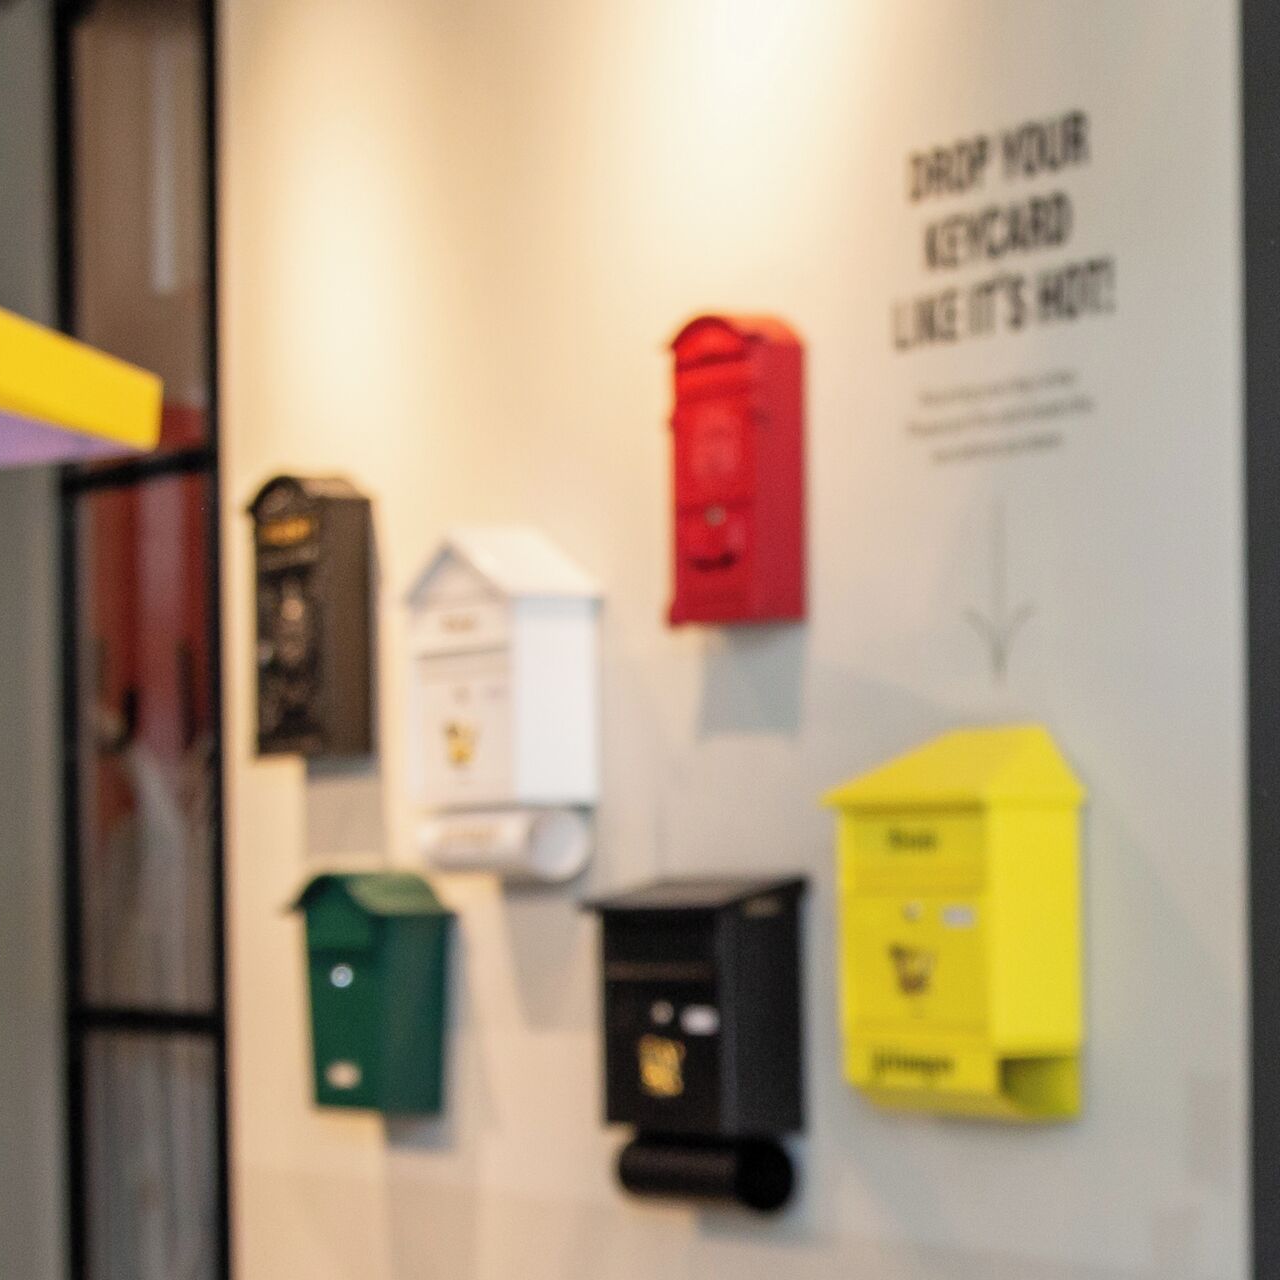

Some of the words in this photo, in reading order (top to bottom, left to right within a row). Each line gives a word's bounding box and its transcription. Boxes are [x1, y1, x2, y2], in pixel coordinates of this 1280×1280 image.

[910, 133, 989, 203] DROP
[1002, 110, 1090, 180] YOUR
[925, 190, 1074, 270] KEYCARD
[894, 288, 958, 348] LIKE
[970, 270, 1025, 330] IT'S
